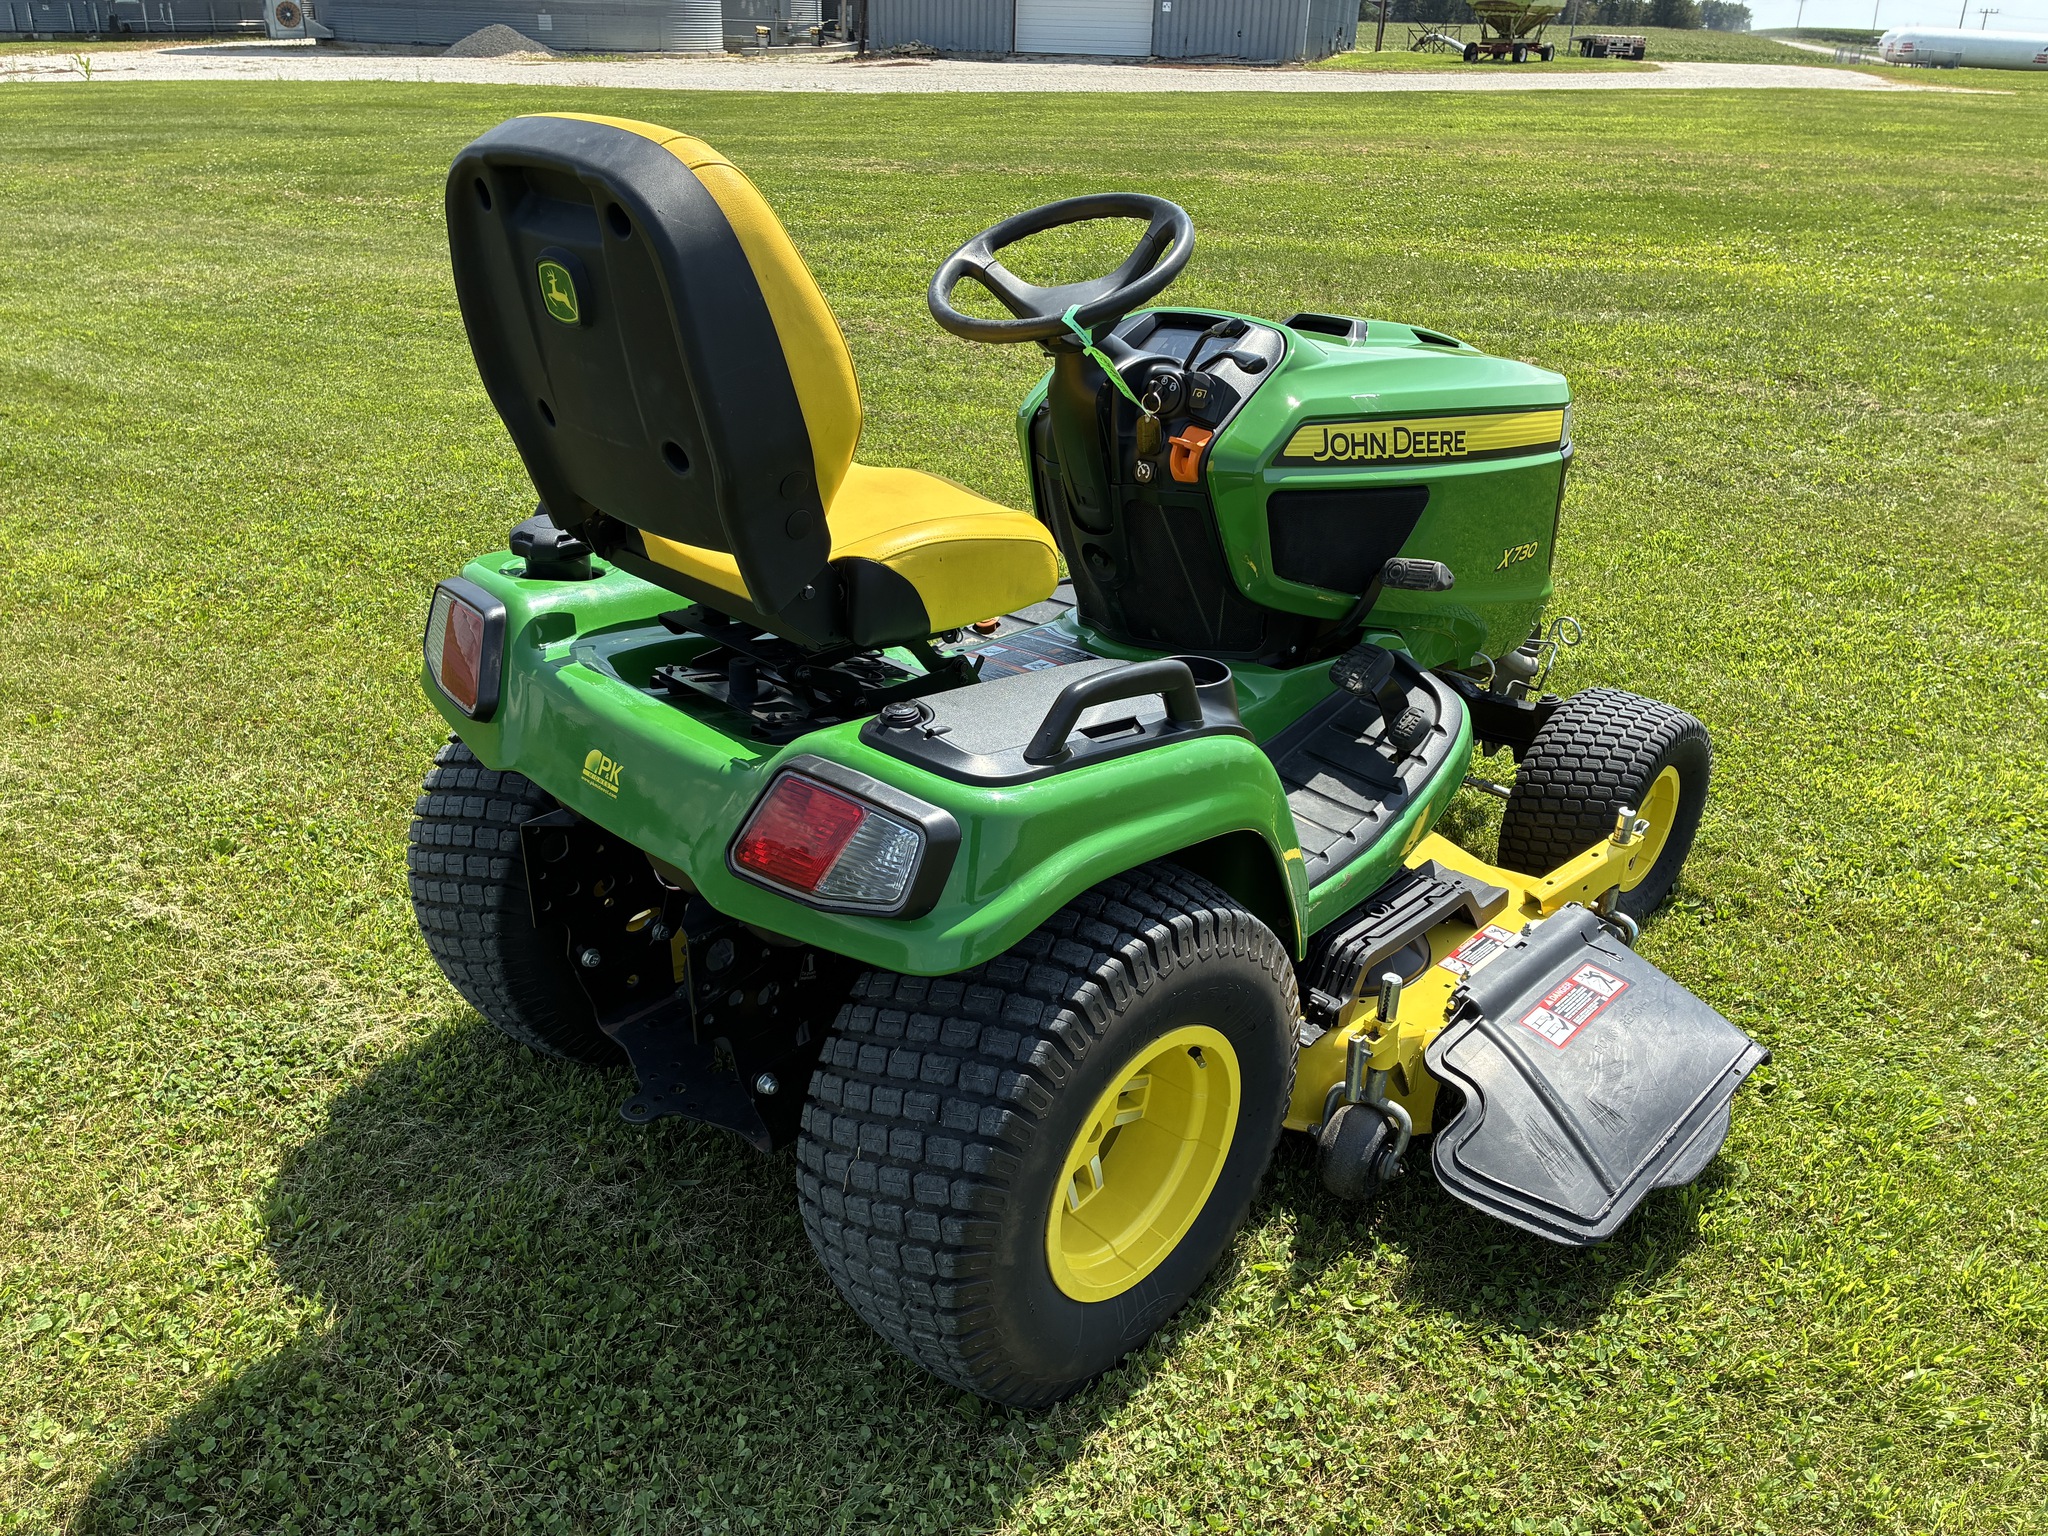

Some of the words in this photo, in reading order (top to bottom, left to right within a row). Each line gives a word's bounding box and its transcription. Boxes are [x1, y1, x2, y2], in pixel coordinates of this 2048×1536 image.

[1313, 428, 1388, 459] JOHN
[1393, 427, 1467, 456] DEERE
[1496, 541, 1539, 570] X730
[1549, 981, 1574, 1001] DANGER
